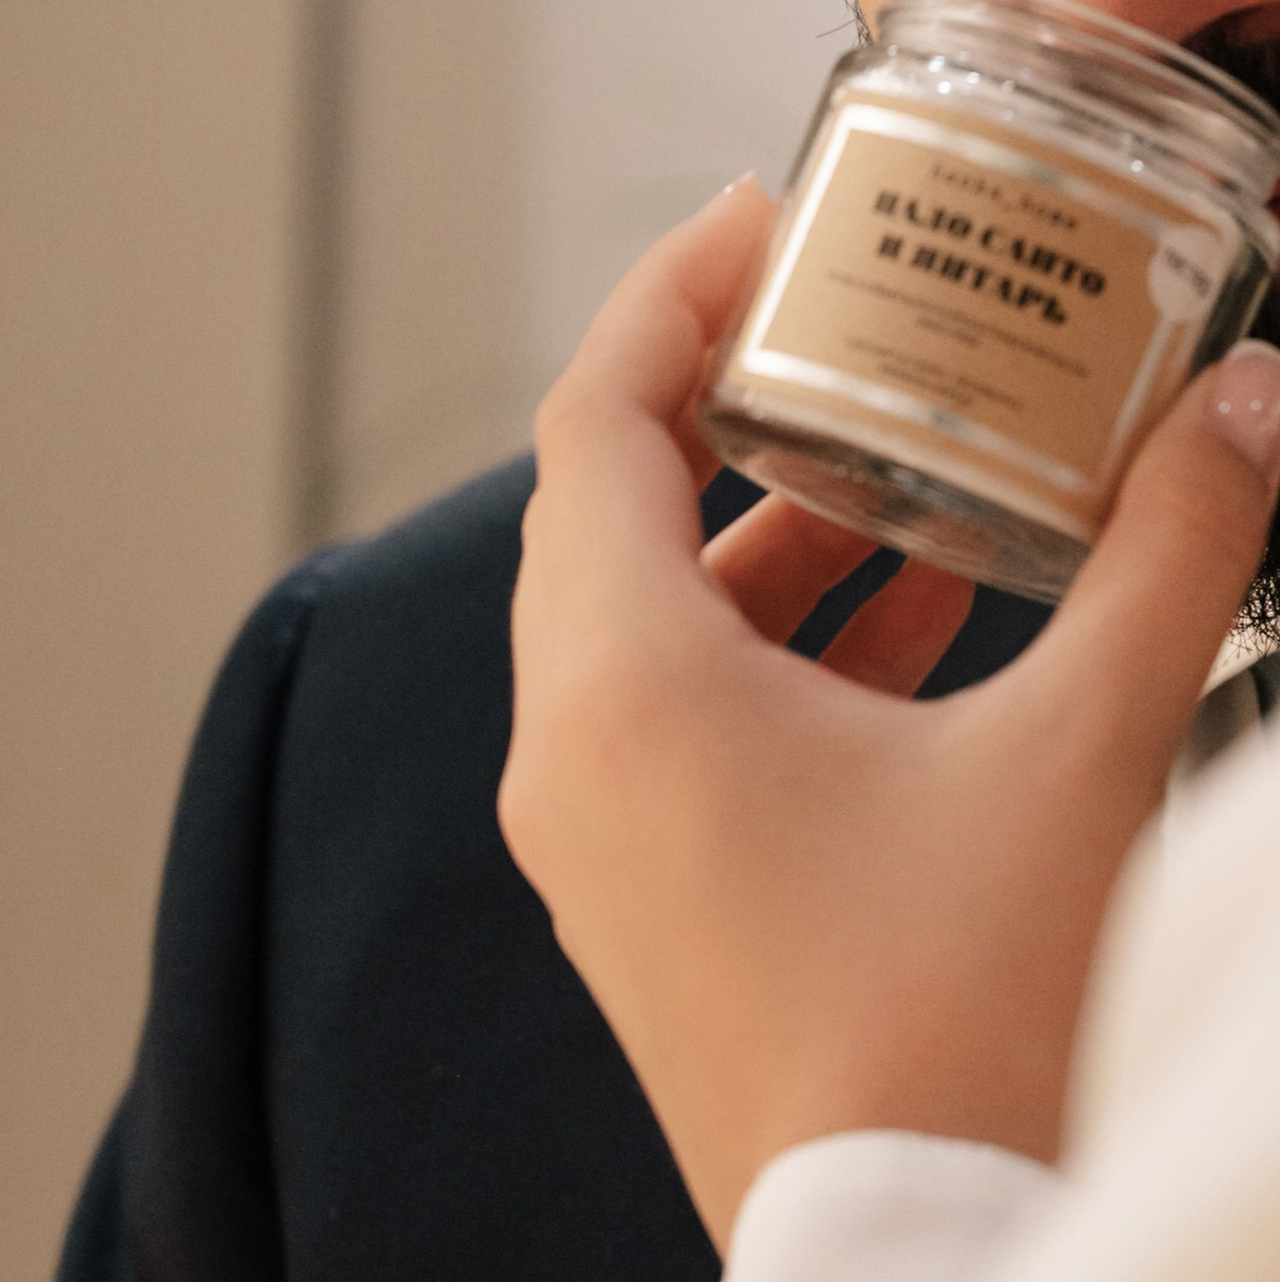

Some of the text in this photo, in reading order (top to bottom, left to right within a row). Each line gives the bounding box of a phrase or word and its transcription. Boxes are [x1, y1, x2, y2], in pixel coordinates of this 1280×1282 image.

[874, 189, 973, 239] ПАЛО
[979, 226, 1106, 297] САНТО
[911, 245, 1067, 325] ЯНТАРЬ
